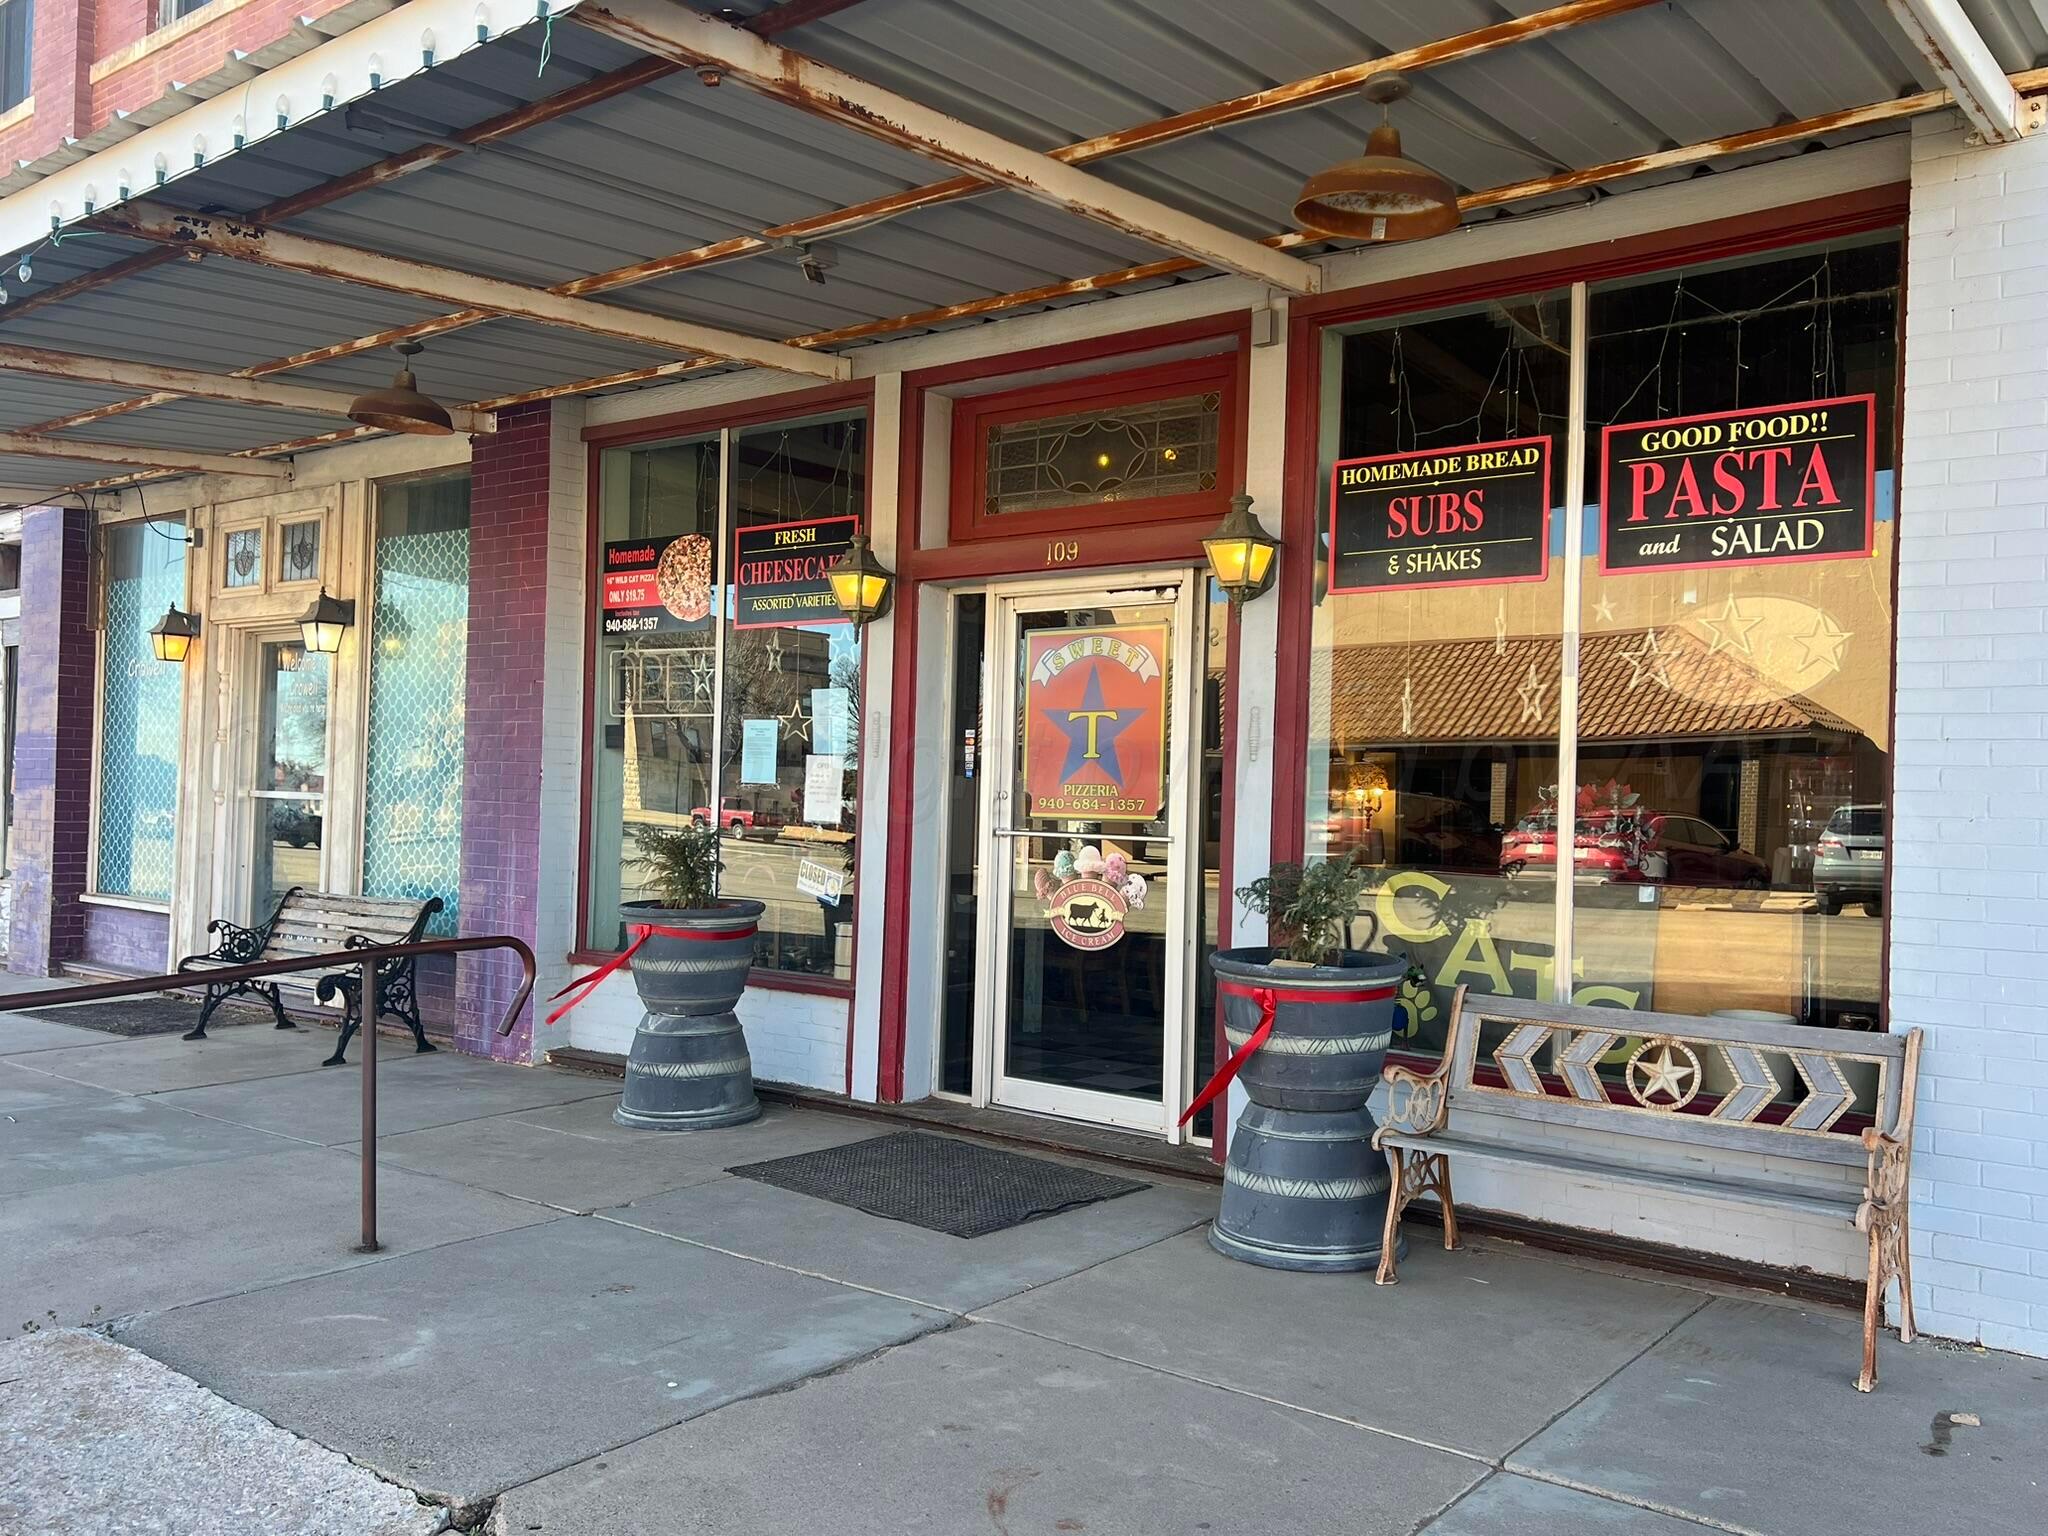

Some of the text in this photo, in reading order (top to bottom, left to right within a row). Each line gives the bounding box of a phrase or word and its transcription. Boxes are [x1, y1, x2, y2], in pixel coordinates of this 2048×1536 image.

[1641, 411, 1828, 452] GOOD FOOD!!
[1342, 448, 1540, 486] HOMEMADE BREAD
[1626, 443, 1841, 522] PASTA
[1387, 489, 1484, 539] SUBS
[774, 528, 817, 545] FRESH
[1639, 519, 1825, 557] and SALAD
[608, 545, 656, 565] Homemade
[1046, 541, 1079, 566] 109
[1387, 548, 1482, 576] & SHAKES
[628, 574, 639, 583] CAT
[640, 573, 655, 582] PIZZA
[608, 589, 625, 603] ONLY
[752, 594, 837, 611] ASSORTED VARIETIES
[605, 617, 659, 632] 940-684-1357
[1052, 637, 1139, 671] SWEET
[1068, 710, 1118, 759] T
[1063, 784, 1119, 797] PIZZERIA
[1038, 797, 1145, 811] 940-684-1357
[800, 861, 827, 886] CLOSED
[1060, 883, 1117, 901] BLUE BELL
[1061, 928, 1115, 948] ICE CREAM
